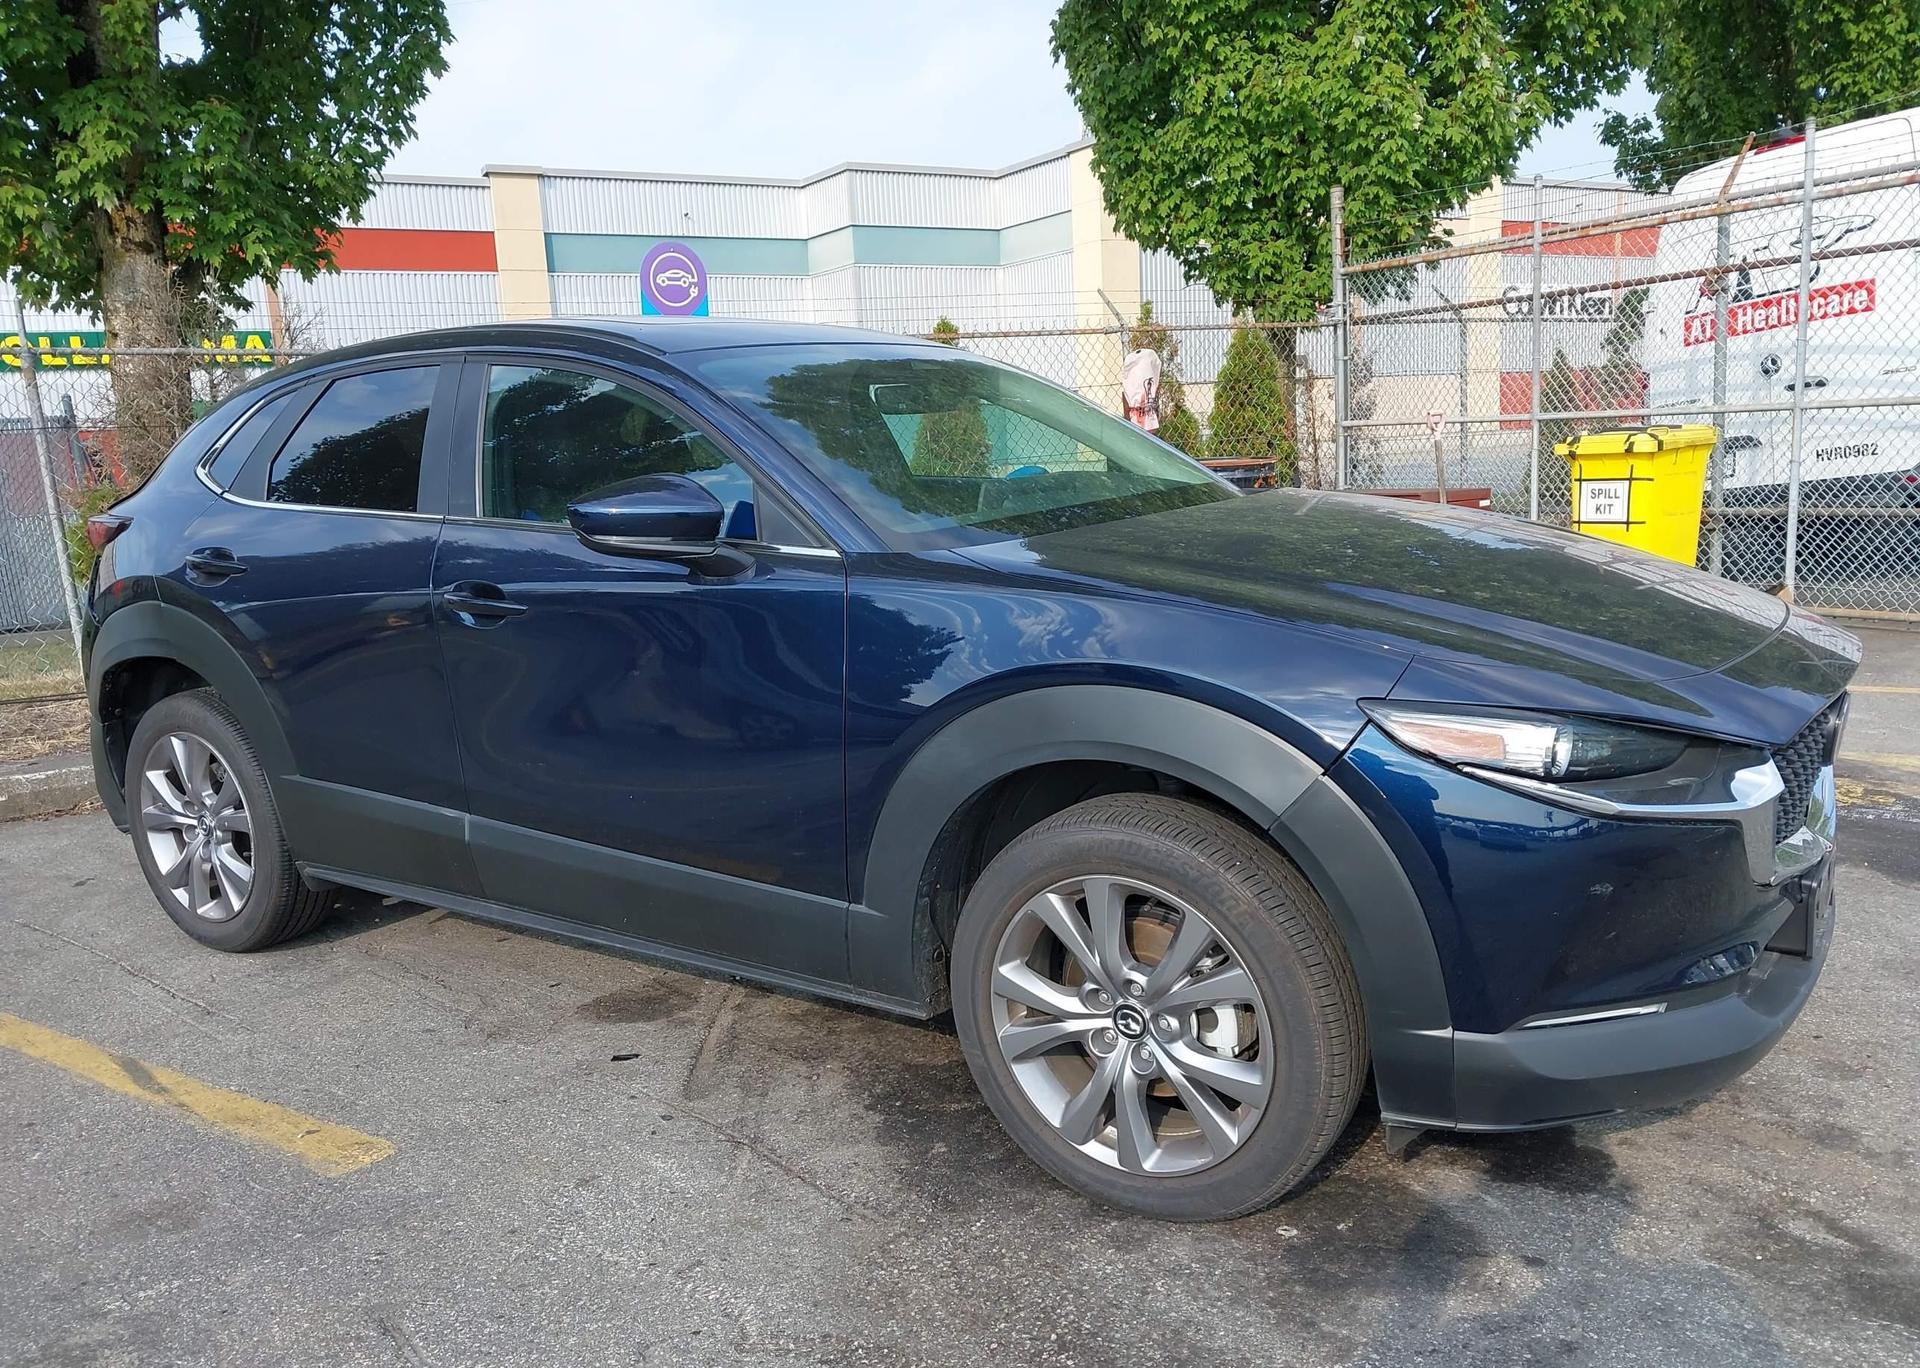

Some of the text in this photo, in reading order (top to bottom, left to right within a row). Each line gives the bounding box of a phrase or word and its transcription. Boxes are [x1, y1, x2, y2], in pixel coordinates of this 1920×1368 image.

[1736, 288, 1869, 333] Healtcare
[1590, 488, 1621, 500] SPILL
[1595, 503, 1615, 515] KIT
